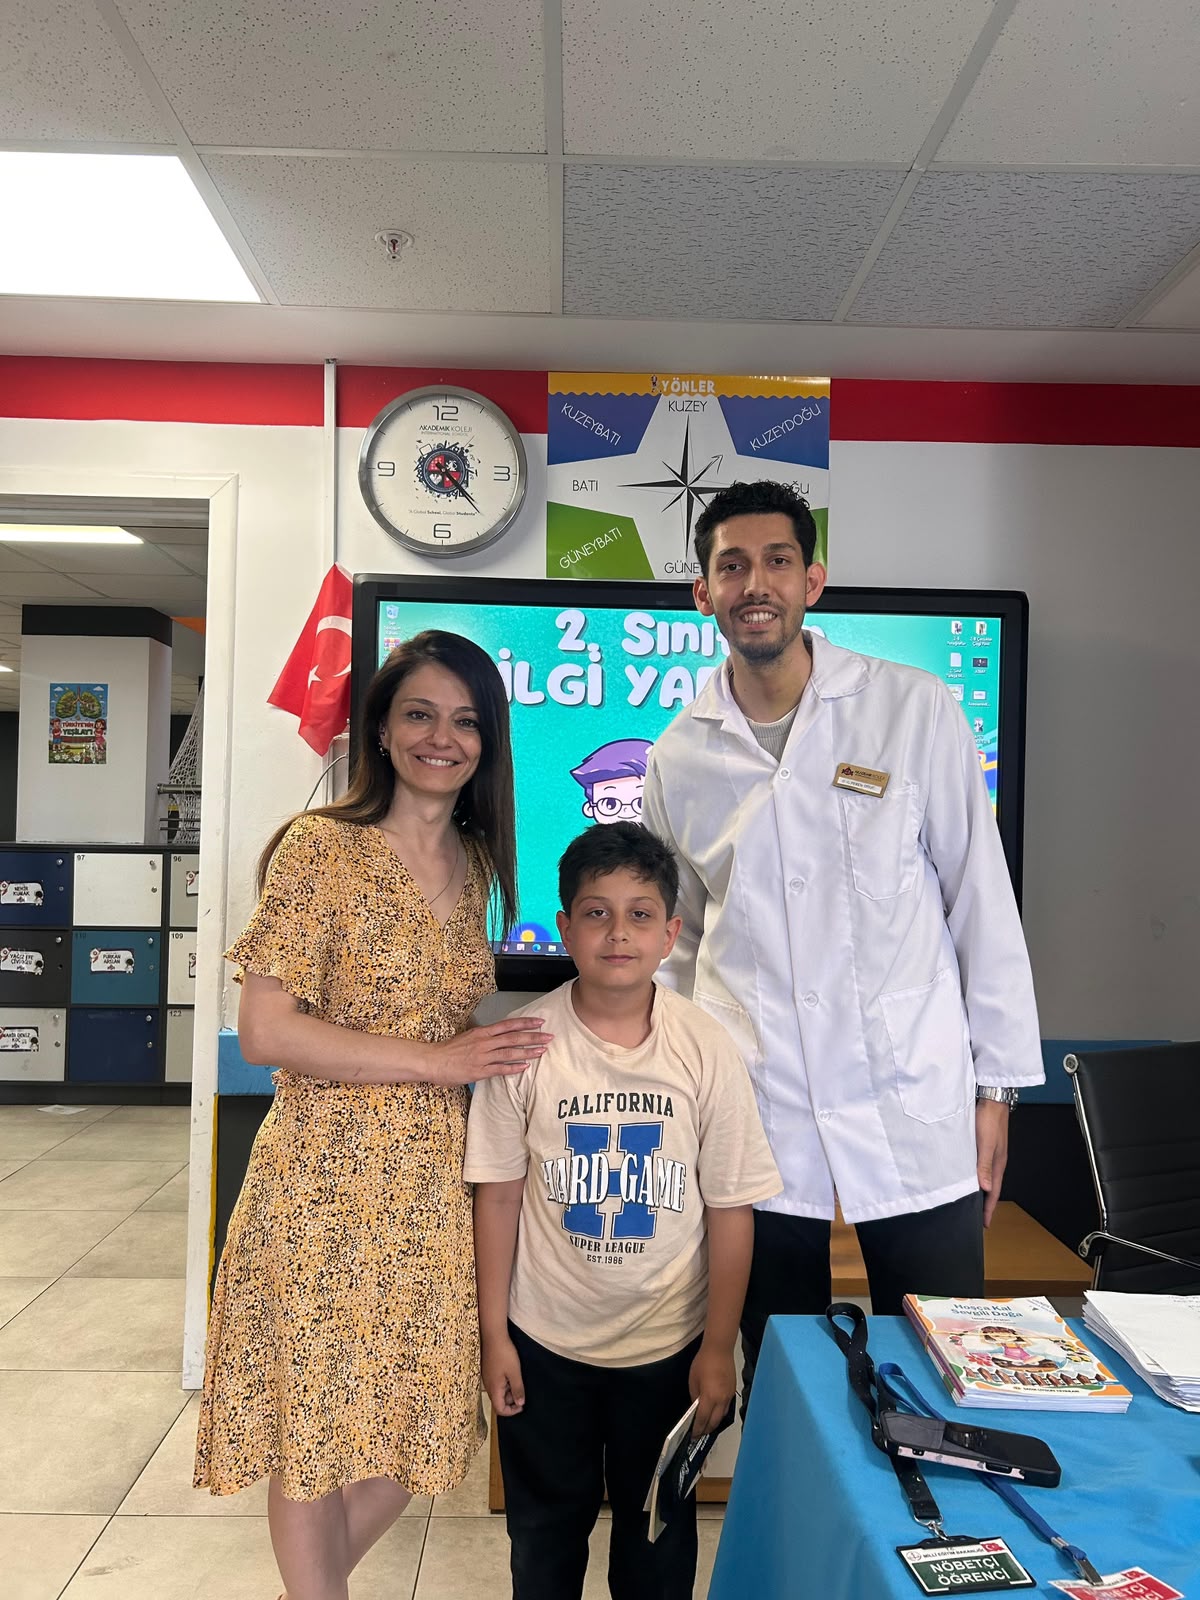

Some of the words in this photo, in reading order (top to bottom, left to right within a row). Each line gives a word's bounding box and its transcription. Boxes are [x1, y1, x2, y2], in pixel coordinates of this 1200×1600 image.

[661, 377, 716, 393] YÖNLER
[432, 405, 459, 421] 12
[668, 400, 708, 412] KUZEY
[560, 402, 622, 447] KUZEYBATI
[749, 403, 822, 451] KUZEYDOĞU
[377, 461, 396, 477] 9
[493, 465, 511, 482] 3
[573, 480, 599, 492] BATI
[433, 523, 452, 539] 6
[559, 527, 623, 569] GÜNEYBATI
[664, 560, 700, 574] GÜNE
[555, 609, 601, 651] 2.
[498, 645, 603, 706] İLGİ
[557, 1092, 674, 1119] CALIFORNIA
[540, 1153, 610, 1206] HARD
[619, 1153, 687, 1213] GAME
[569, 1235, 601, 1253] SUPER
[605, 1242, 645, 1254] LEAGUE
[586, 1254, 623, 1265] EST.1986
[929, 1555, 1000, 1574] NÖBETÇİ
[938, 1567, 1011, 1586] ÖĞRENCİ
